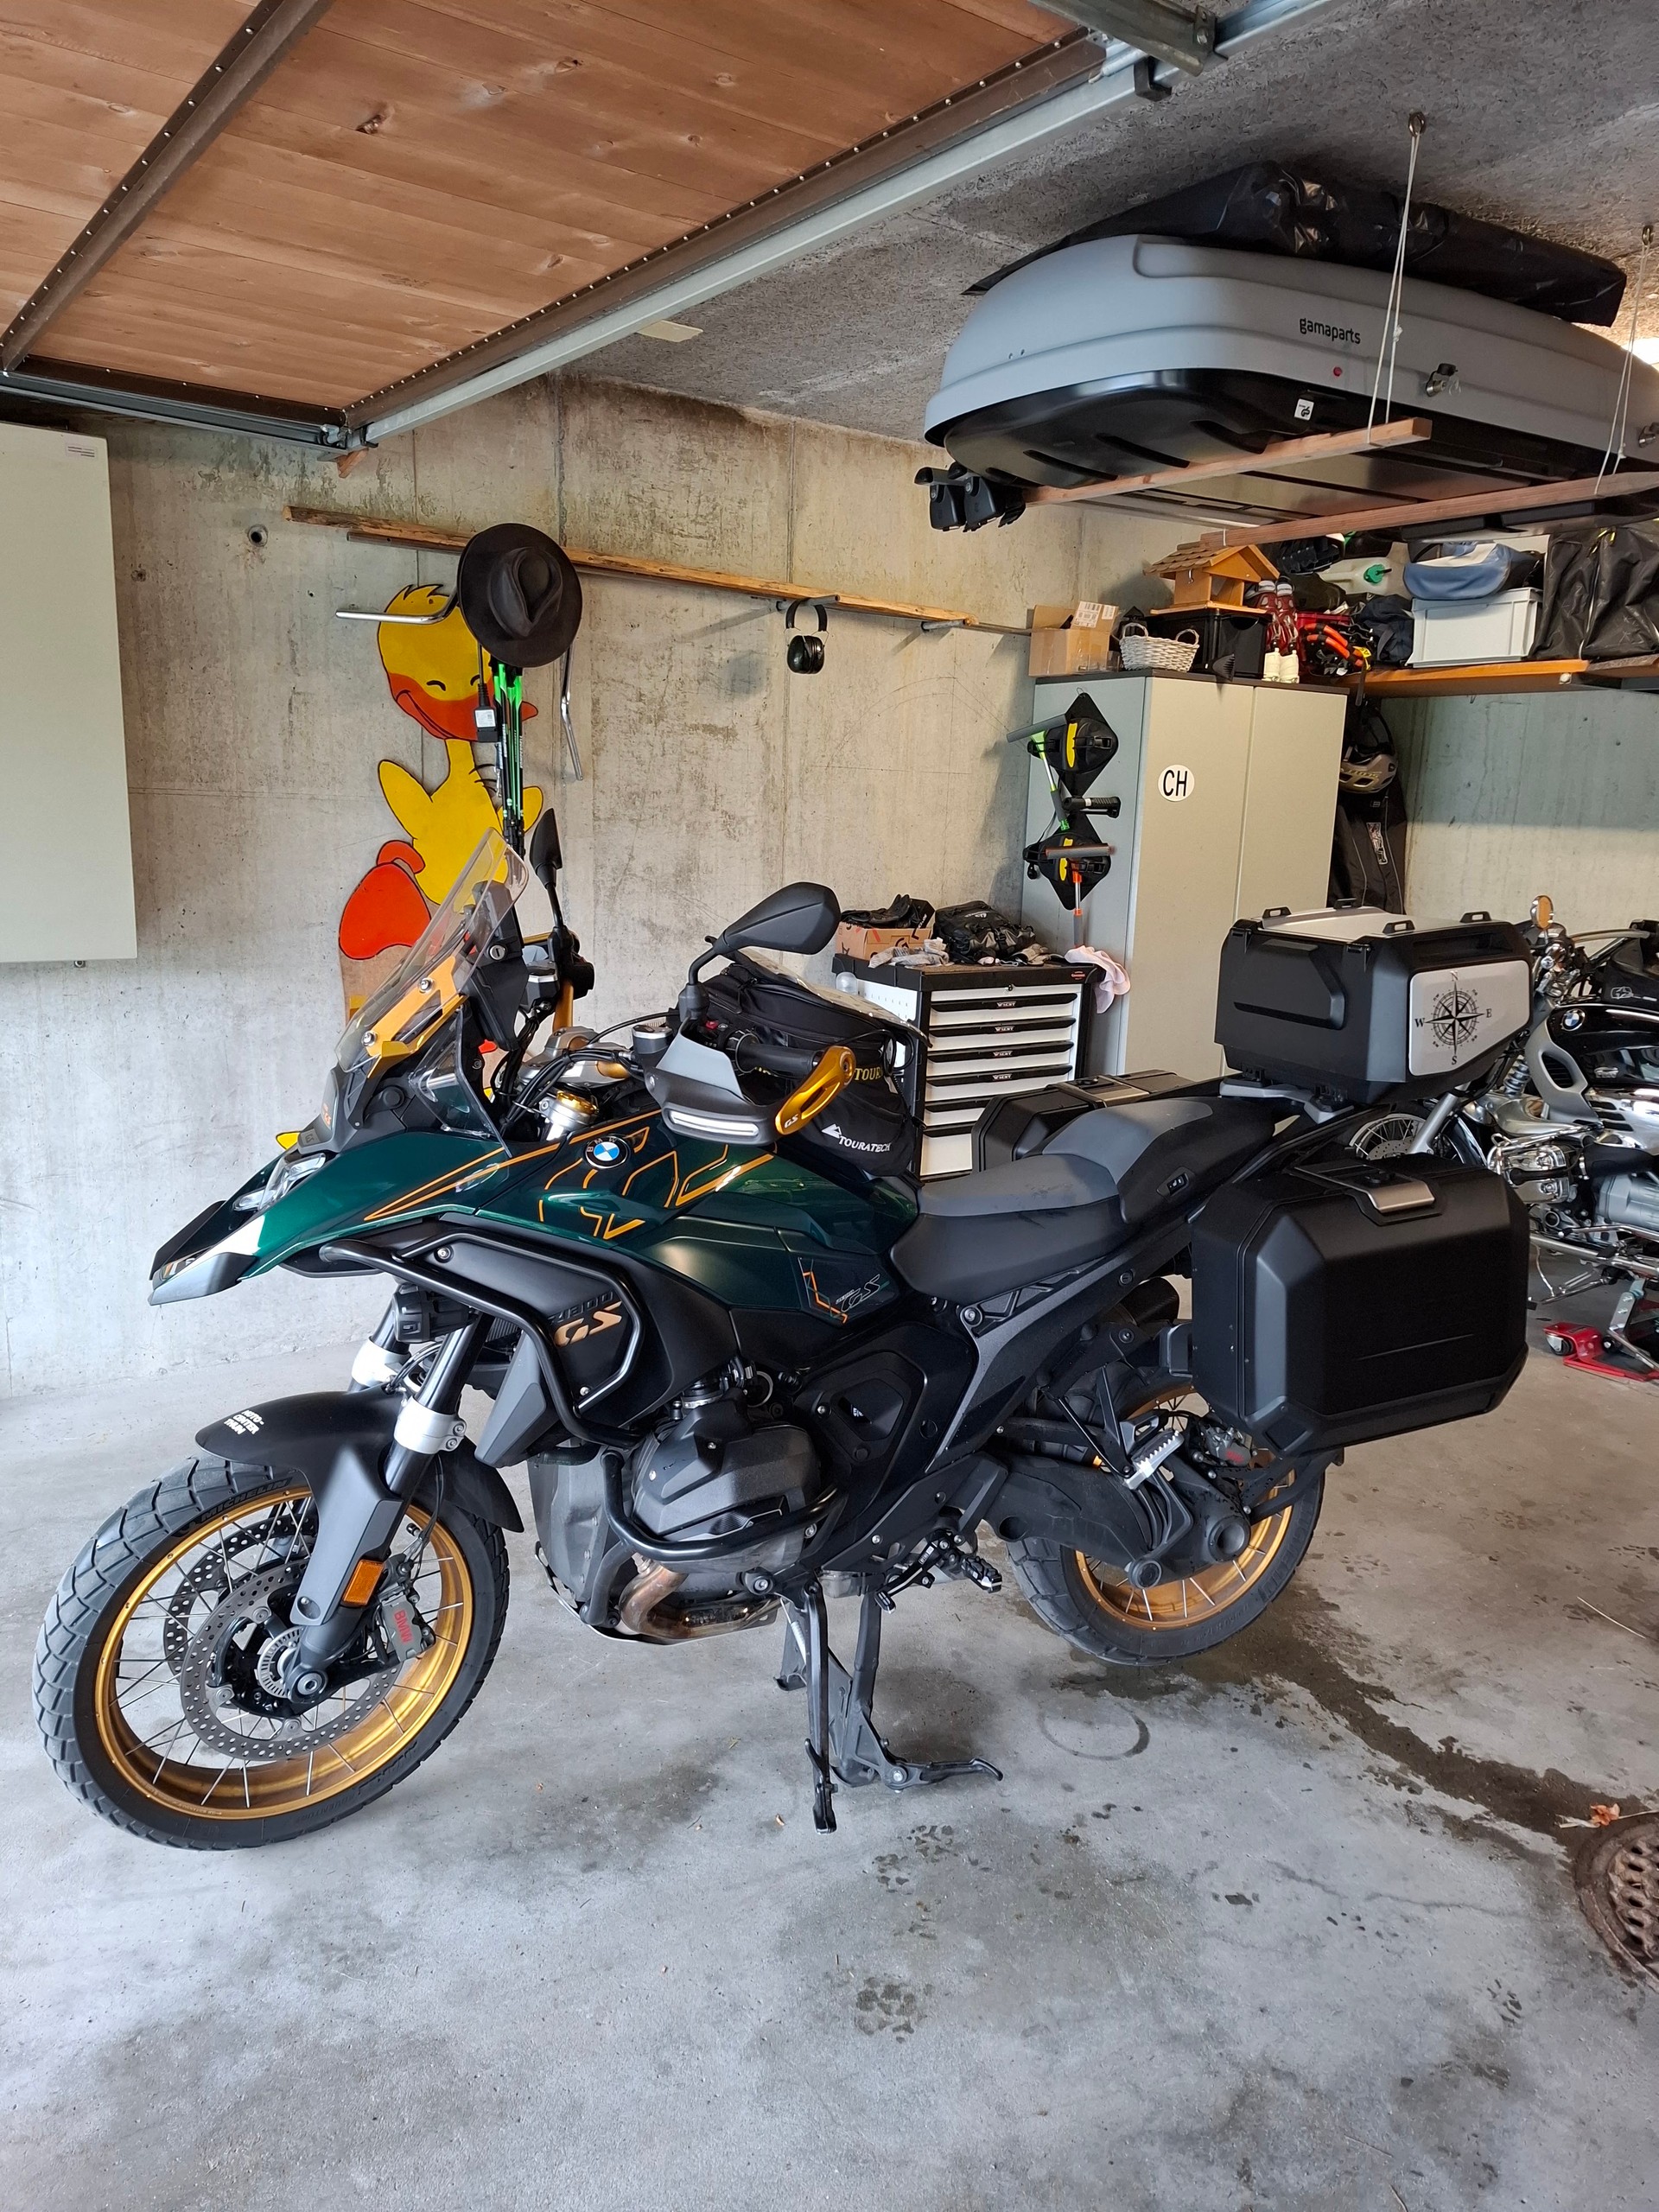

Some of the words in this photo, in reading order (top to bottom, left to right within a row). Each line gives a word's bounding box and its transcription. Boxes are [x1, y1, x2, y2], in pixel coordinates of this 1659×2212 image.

[1299, 317, 1361, 345] gamaparts
[1162, 769, 1188, 797] CH
[1414, 1018, 1426, 1028] W
[1485, 1007, 1492, 1019] E
[1451, 1055, 1458, 1065] S
[854, 1066, 882, 1081] TOUR
[784, 1113, 799, 1128] GS
[839, 1135, 893, 1154] TOURATECH
[554, 1300, 622, 1347] GS
[232, 1414, 260, 1435] CENTER
[200, 1478, 292, 1522] MICHELIN
[394, 1610, 414, 1643] BMW
